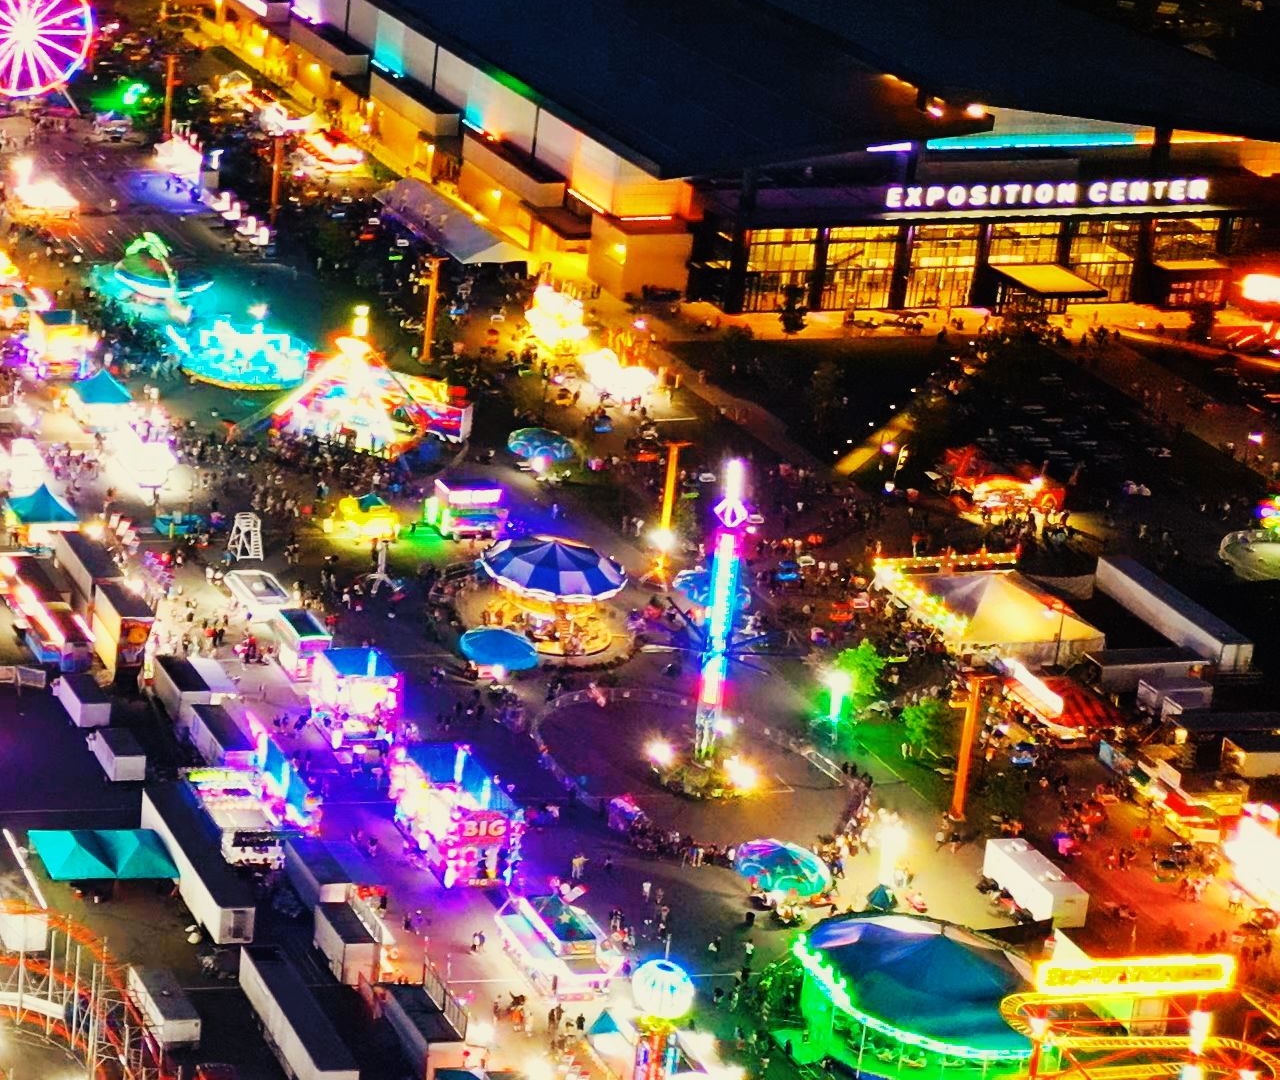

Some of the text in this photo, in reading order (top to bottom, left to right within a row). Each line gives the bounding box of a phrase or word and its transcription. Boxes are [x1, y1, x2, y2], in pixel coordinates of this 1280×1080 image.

[885, 178, 1210, 208] EXPOSITION CENTER
[463, 820, 507, 837] BIG
